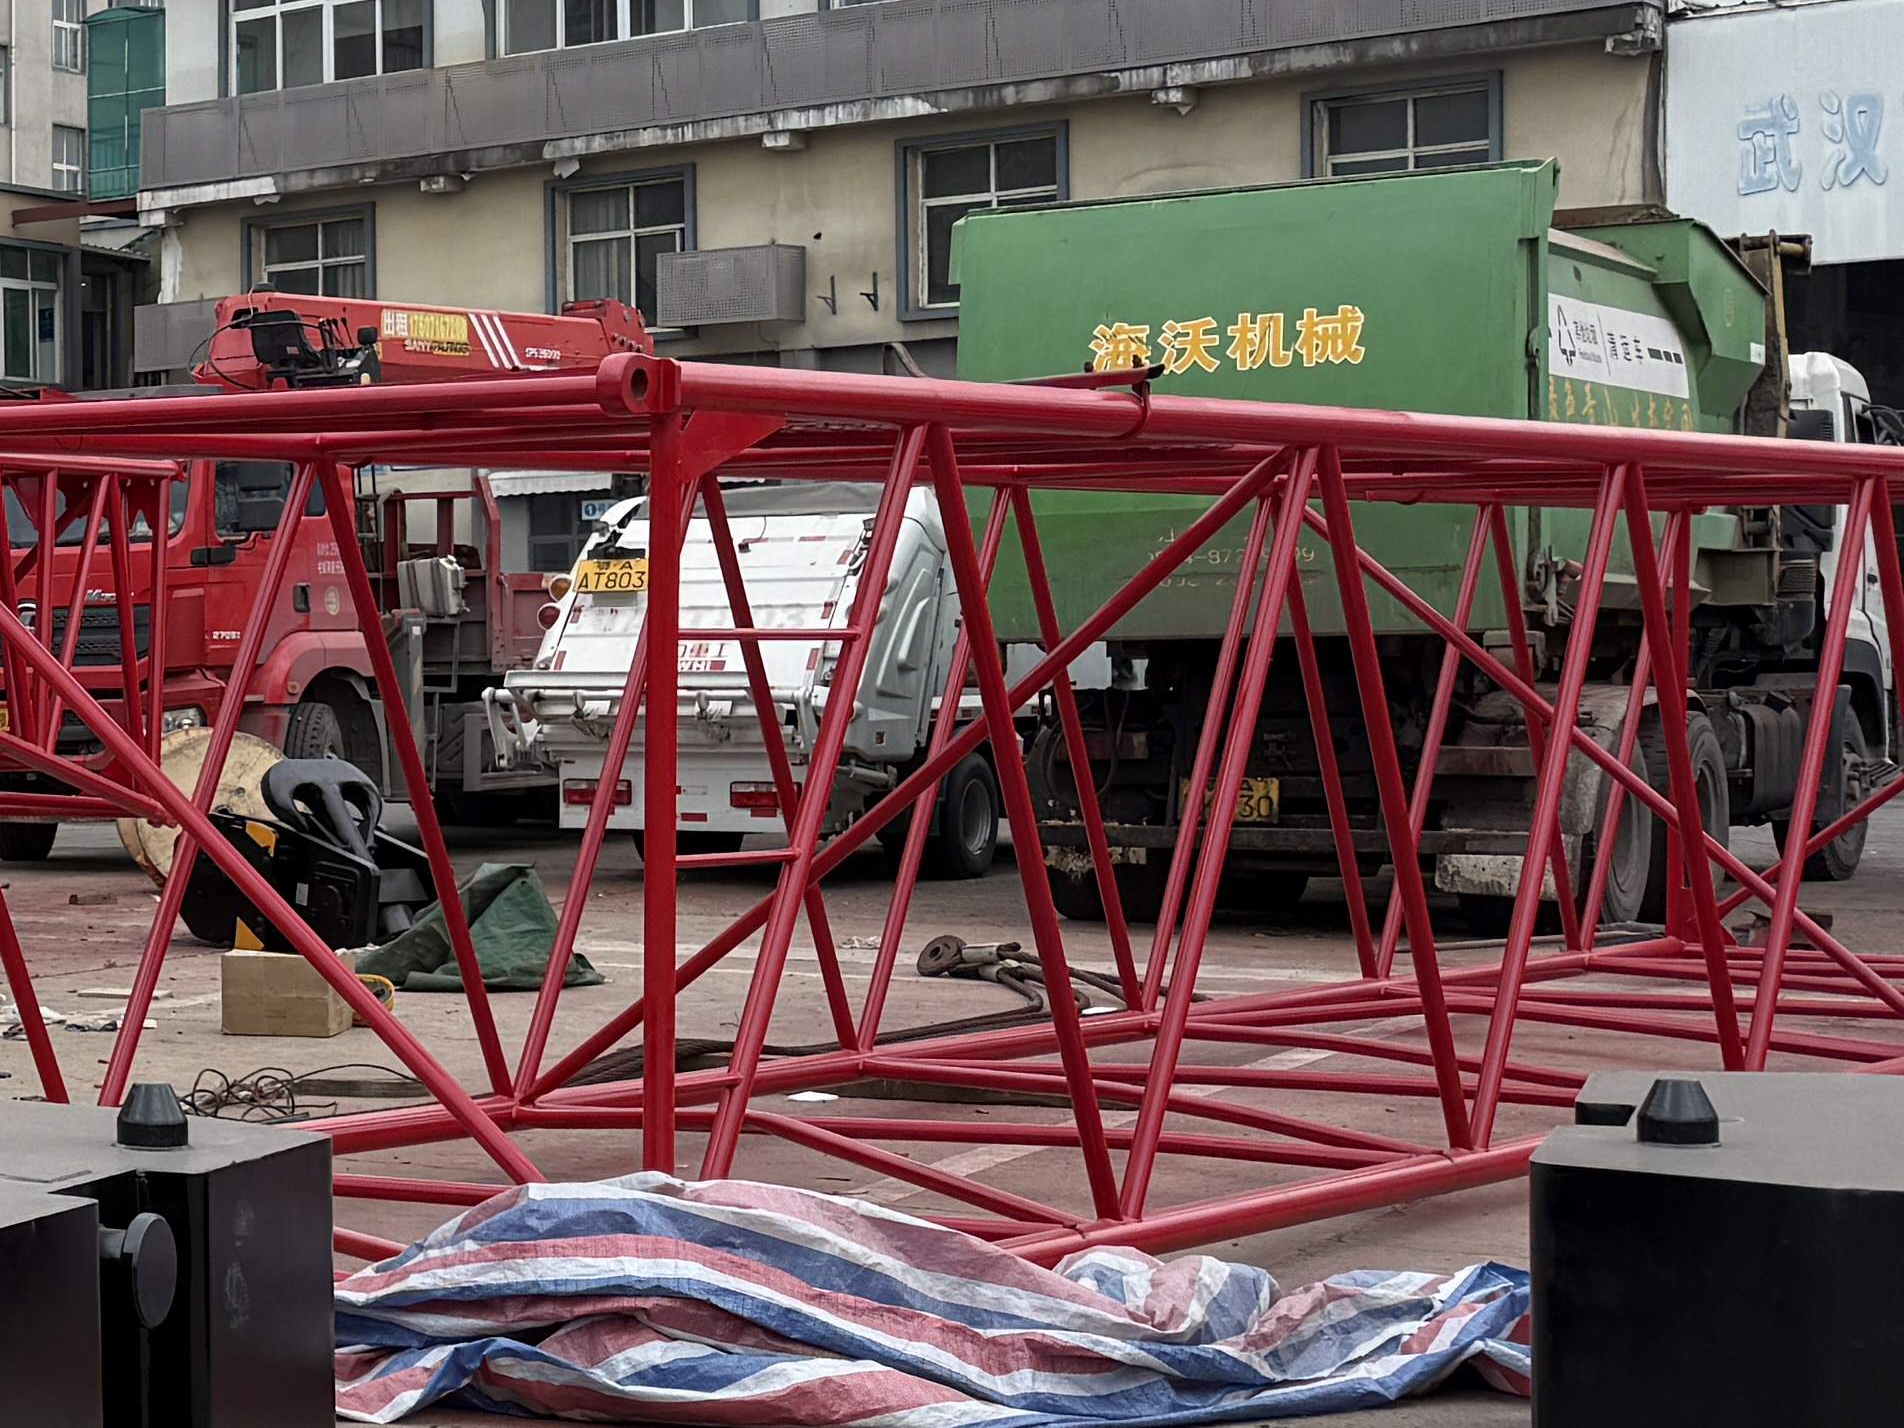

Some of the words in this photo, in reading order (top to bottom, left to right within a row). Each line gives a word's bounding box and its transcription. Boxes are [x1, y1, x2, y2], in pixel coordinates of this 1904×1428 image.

[1737, 90, 1889, 196] 武汉
[1089, 306, 1366, 374] 海沃机械
[577, 571, 646, 589] AT803
